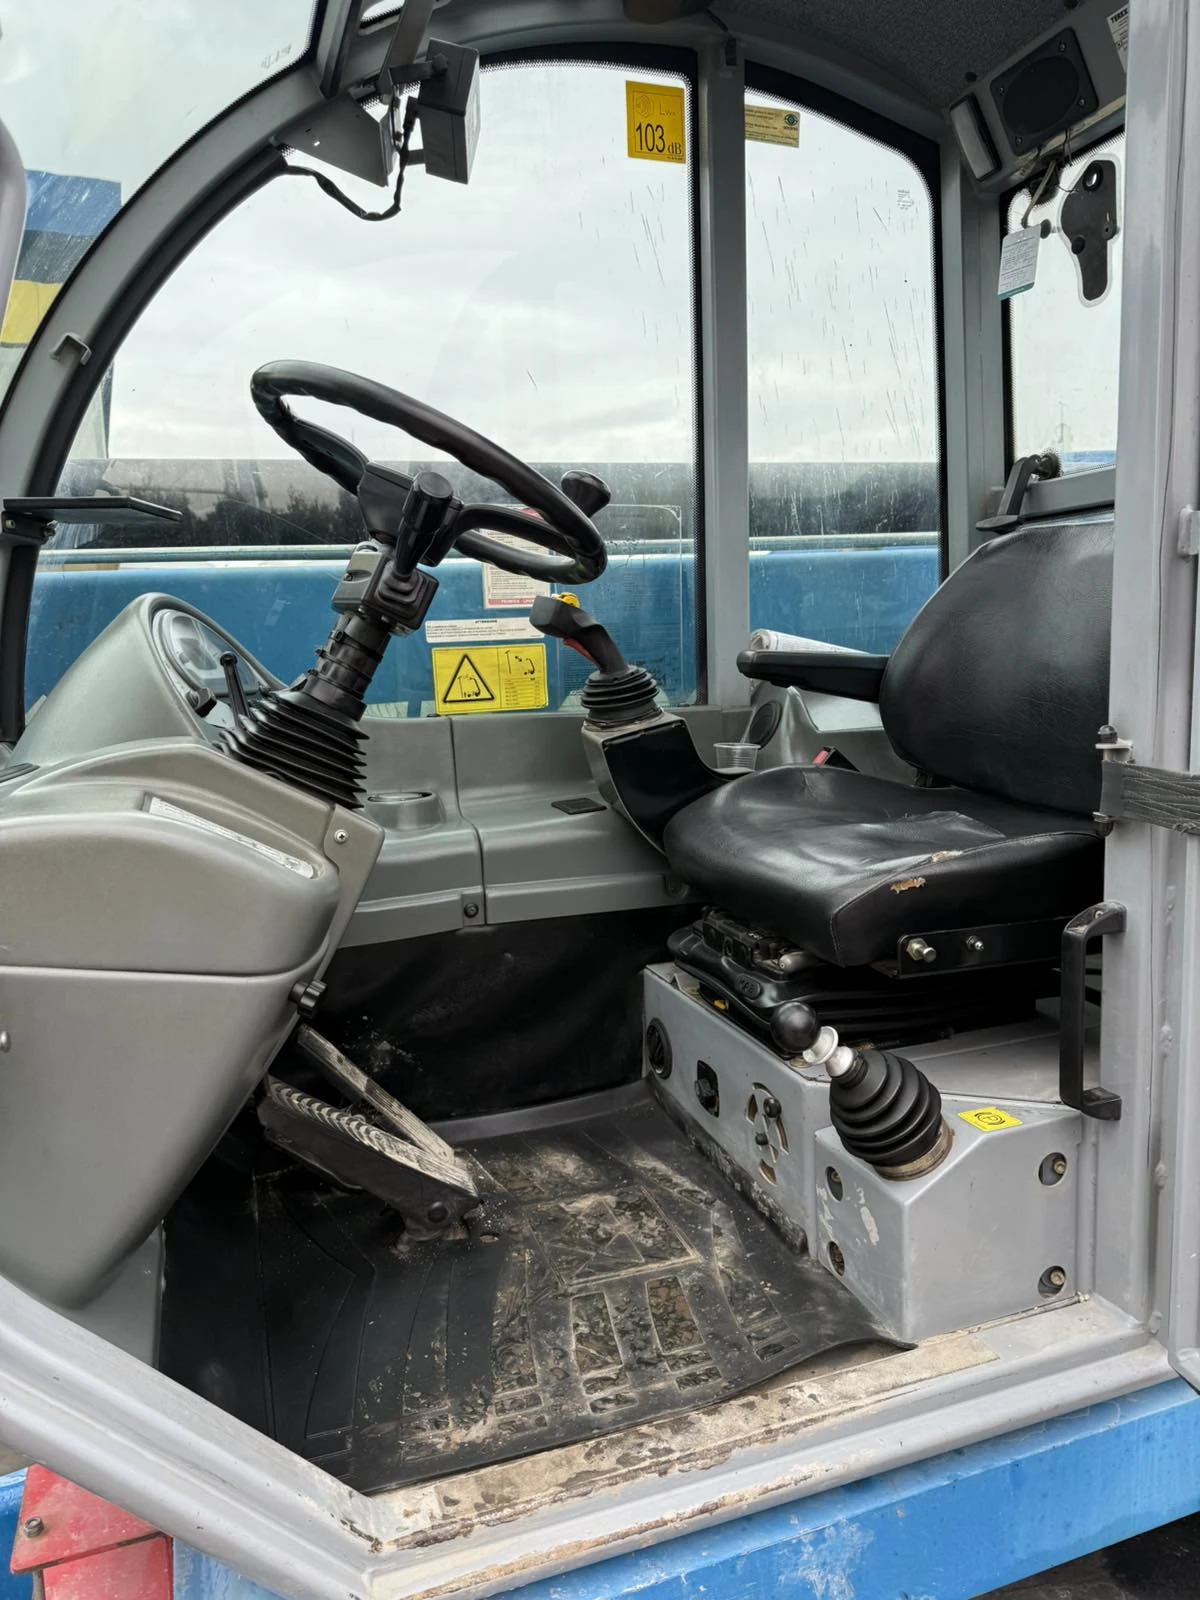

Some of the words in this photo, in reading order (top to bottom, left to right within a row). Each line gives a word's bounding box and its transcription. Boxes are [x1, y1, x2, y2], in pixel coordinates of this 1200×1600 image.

[1110, 7, 1129, 24] TEREX
[635, 122, 666, 153] 103
[667, 142, 682, 155] dB
